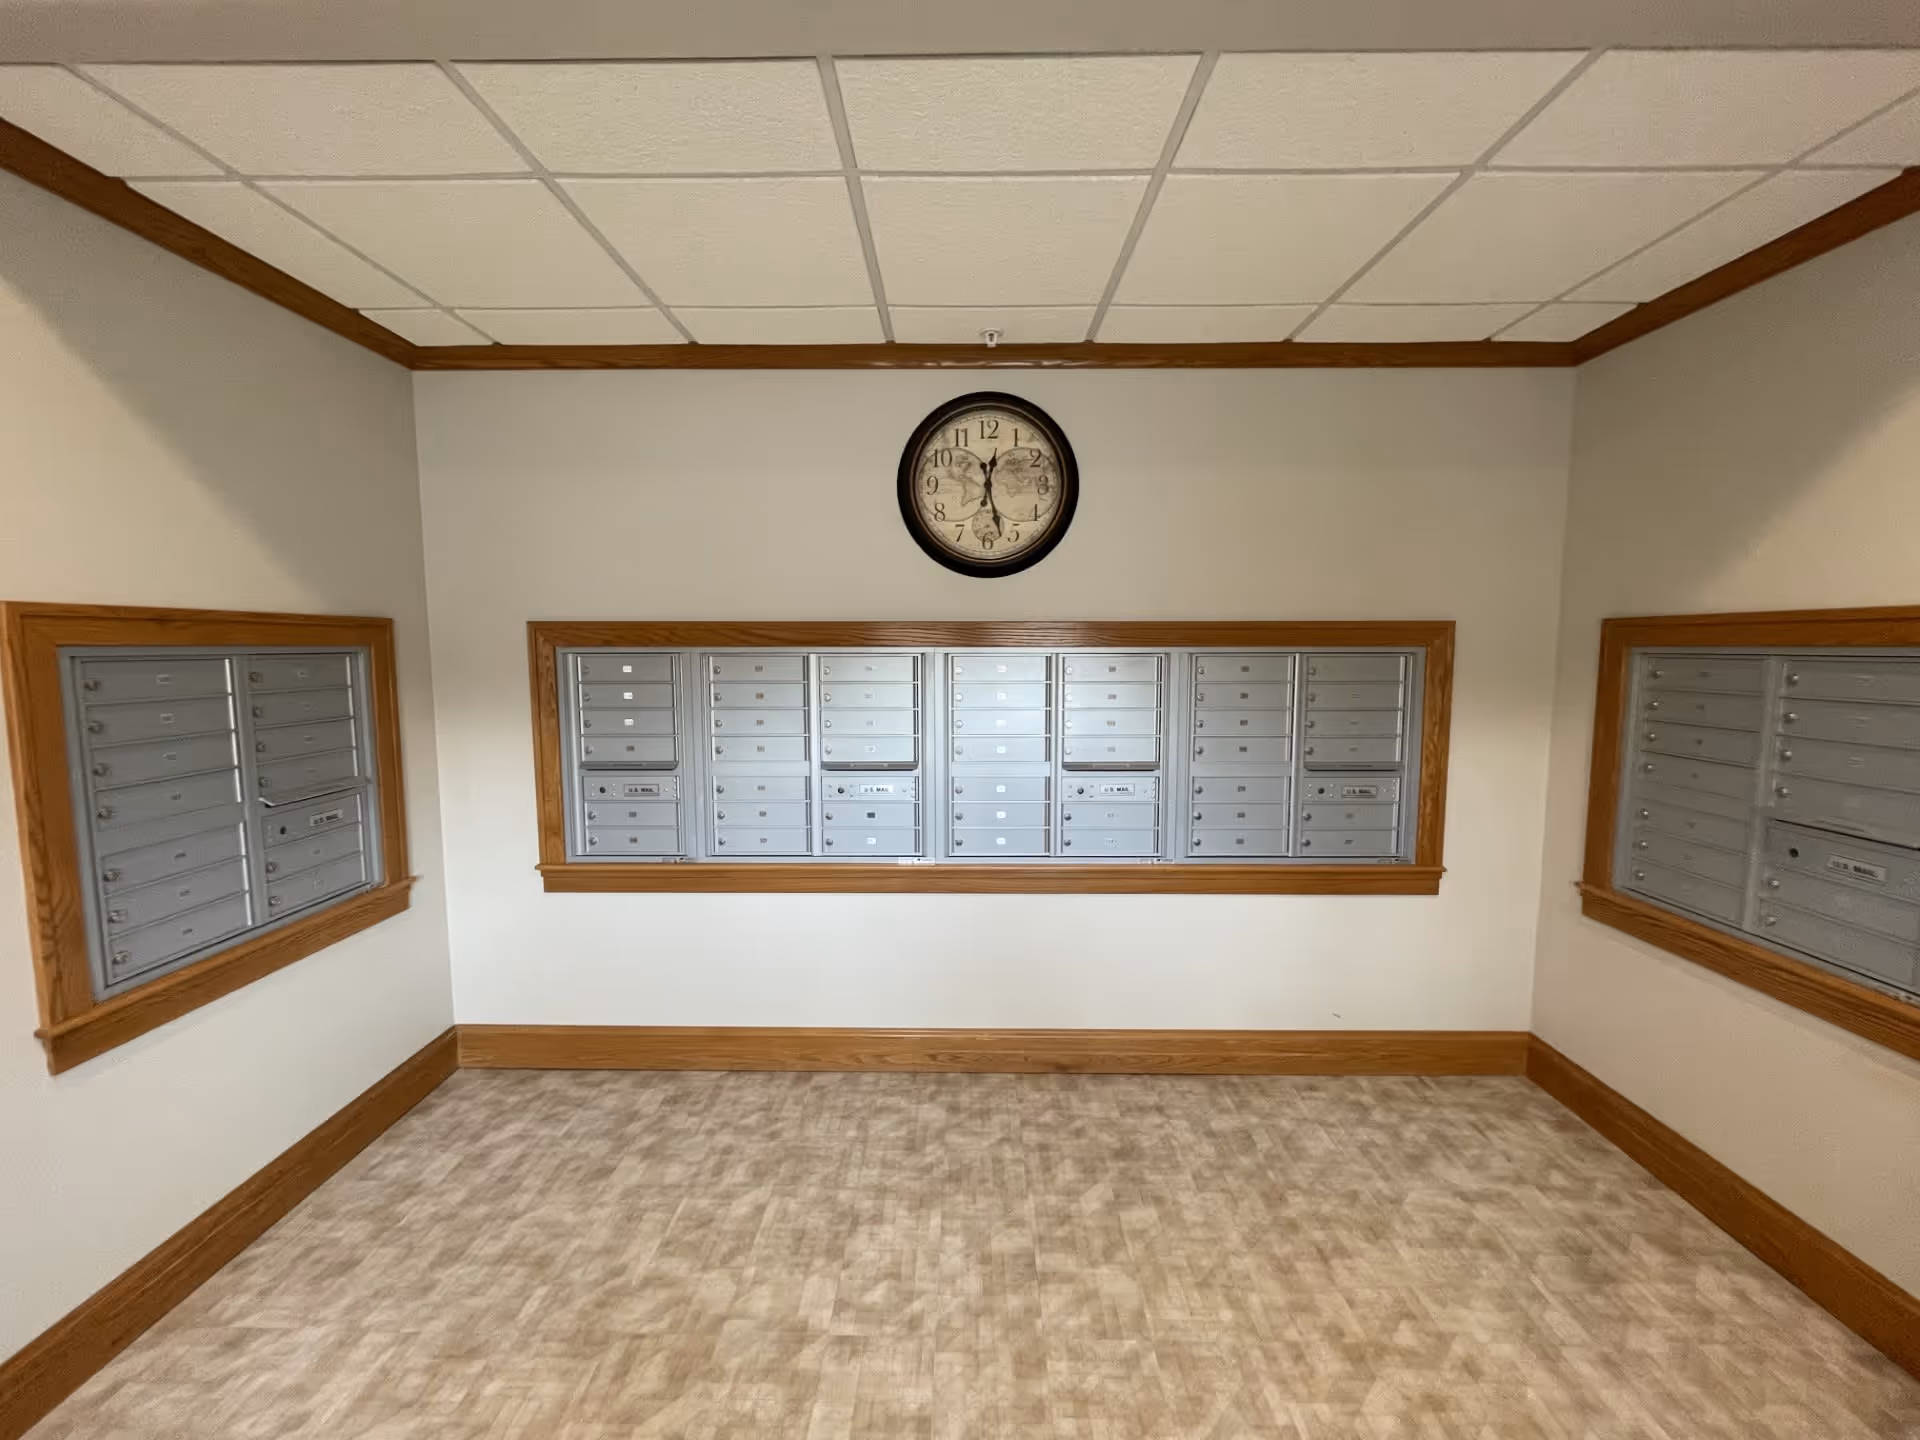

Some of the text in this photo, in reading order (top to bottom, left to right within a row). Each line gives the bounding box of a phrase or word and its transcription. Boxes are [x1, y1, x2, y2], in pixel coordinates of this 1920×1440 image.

[954, 428, 969, 447] 11
[978, 419, 1000, 440] 12
[1012, 428, 1020, 447] 1
[932, 448, 953, 468] 10
[1029, 448, 1042, 468] 2
[926, 475, 939, 495] 9
[933, 502, 946, 522] 8
[1030, 503, 1042, 522] 4
[954, 523, 965, 543] 7
[981, 530, 994, 550] 6
[1007, 523, 1021, 543] 5
